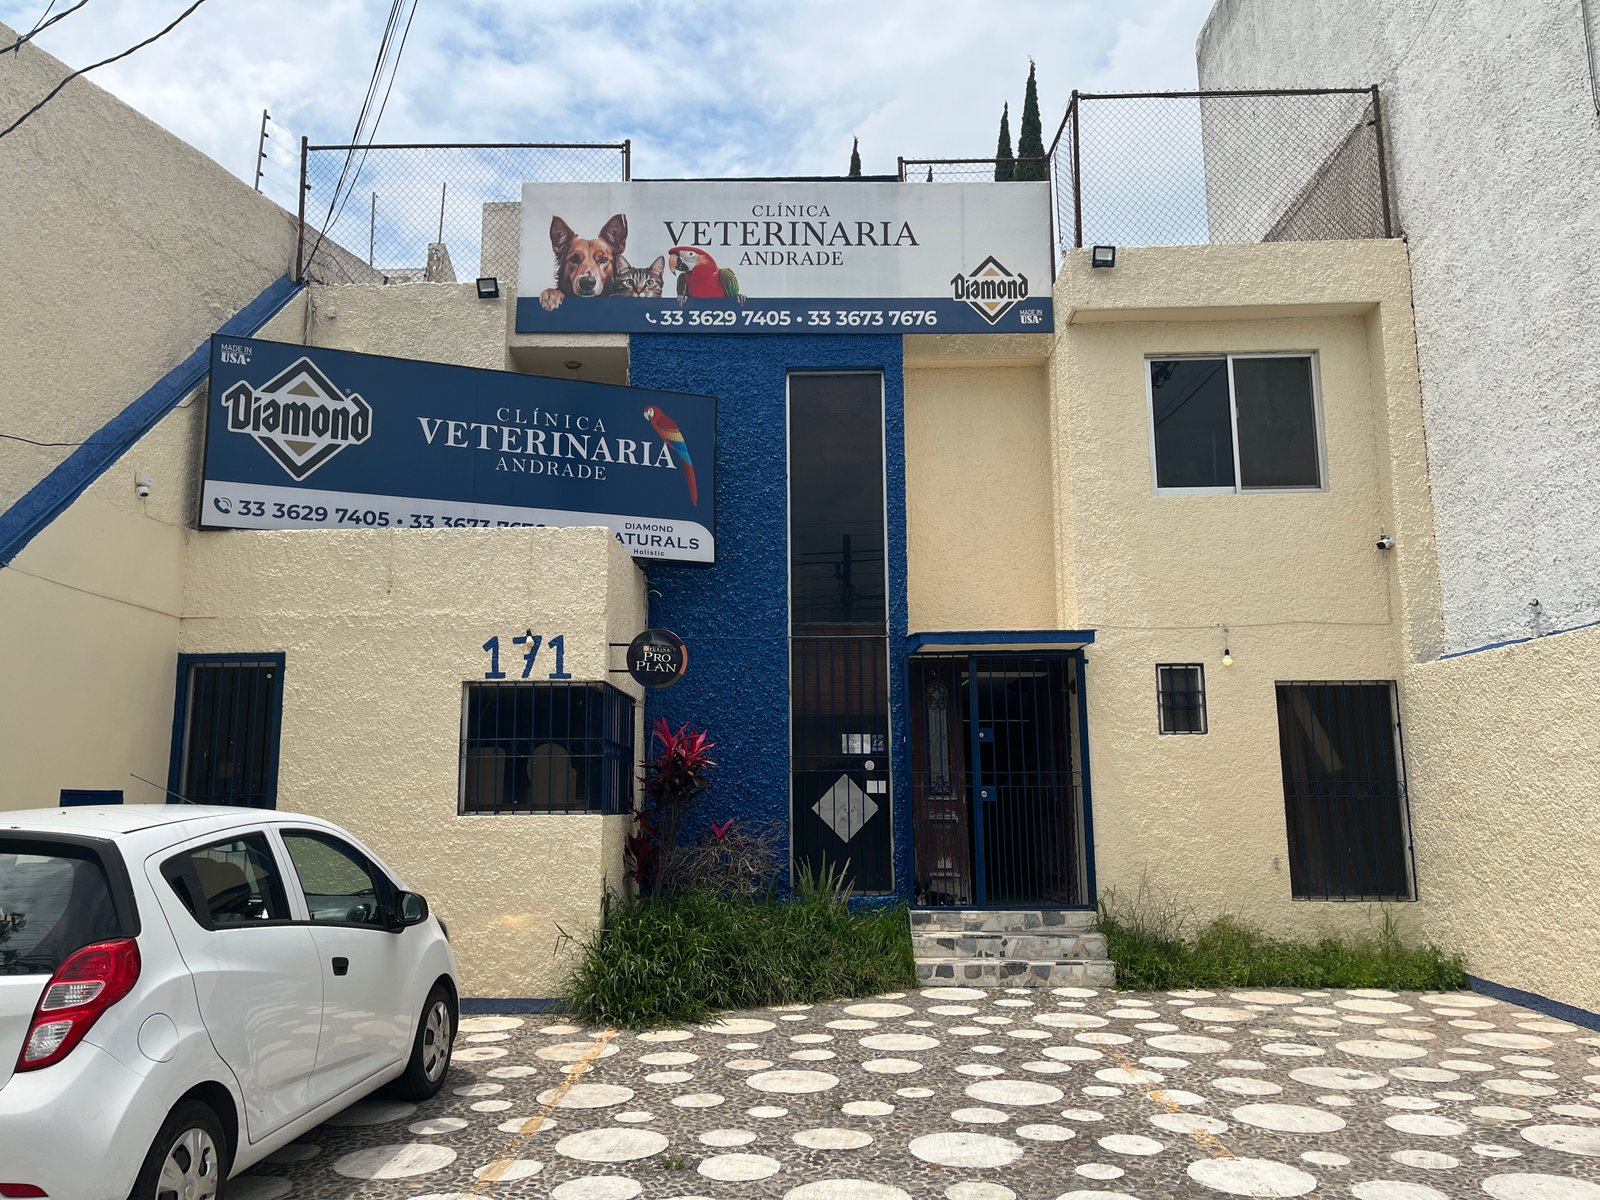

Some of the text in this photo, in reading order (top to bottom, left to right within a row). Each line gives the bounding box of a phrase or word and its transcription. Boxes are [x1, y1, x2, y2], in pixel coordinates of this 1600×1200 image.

[752, 203, 830, 217] CLÍNICA
[663, 221, 920, 246] VETERINARIA
[739, 251, 844, 266] ANDRADE
[951, 272, 1028, 299] Diamond
[660, 310, 938, 326] 33 3629 7405 33 3673 7676
[221, 343, 252, 354] MADE IN
[221, 352, 246, 365] USA
[224, 382, 370, 442] Diamond
[496, 407, 606, 432] CLÍNICA
[416, 416, 677, 469] VETERINARIA
[496, 456, 607, 481] ANDRADE
[237, 500, 265, 517] 33
[272, 503, 328, 522] 3629
[335, 508, 390, 526] 7405
[409, 514, 434, 528] 33
[625, 522, 673, 533] DIAMOND
[615, 532, 699, 550] ATURALS
[633, 548, 665, 557] Holistic
[482, 634, 572, 679] 171
[643, 651, 671, 662] PRO
[636, 660, 677, 673] PLAN
